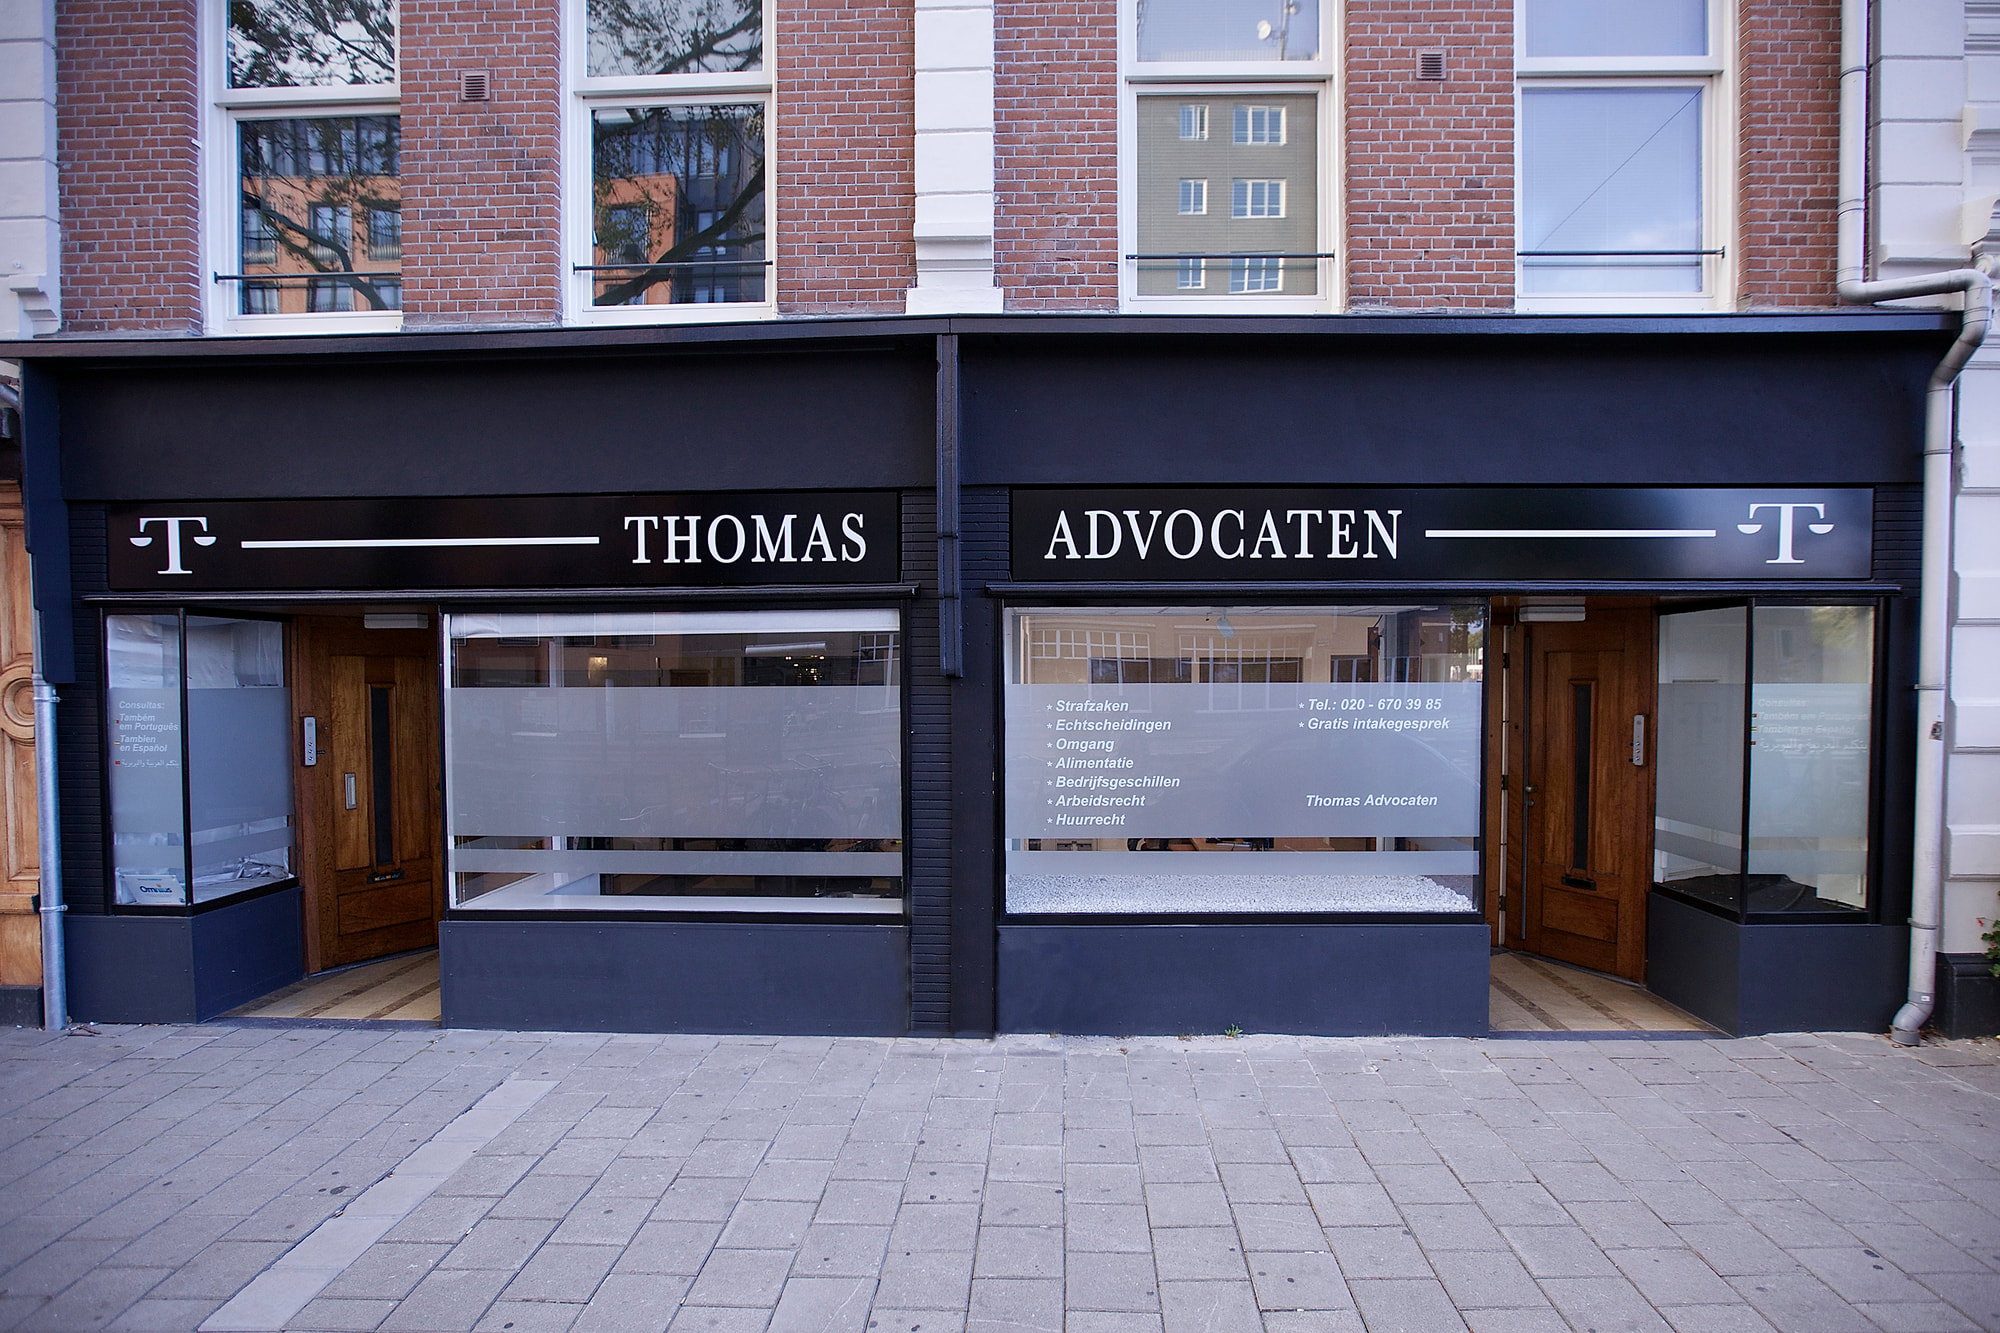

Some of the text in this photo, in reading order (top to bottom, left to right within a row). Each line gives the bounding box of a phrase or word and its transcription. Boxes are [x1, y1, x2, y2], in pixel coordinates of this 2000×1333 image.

[625, 513, 866, 563] THOMAS
[1044, 510, 1402, 559] ADVOCATEN
[119, 700, 165, 710] Consultas:
[1056, 700, 1128, 711] Strafzaken
[1309, 699, 1336, 710] Tel.:
[1341, 699, 1365, 710] 020
[1378, 699, 1401, 710] 670
[1406, 699, 1421, 710] 39
[1426, 699, 1441, 709] 85
[134, 722, 178, 732] Português
[1056, 719, 1171, 733] Echtscheidingen
[1308, 718, 1449, 732] Gratis intakegesprek
[132, 744, 168, 753] Español
[1057, 738, 1114, 752] Omgang
[1055, 757, 1133, 768] Alimentatie
[1056, 776, 1180, 790] Bedrijfsgeschillen
[1055, 795, 1145, 806] Arbeidsrecht
[1307, 794, 1437, 806] Thomas Advocaten
[1056, 814, 1125, 825] Huurrecht
